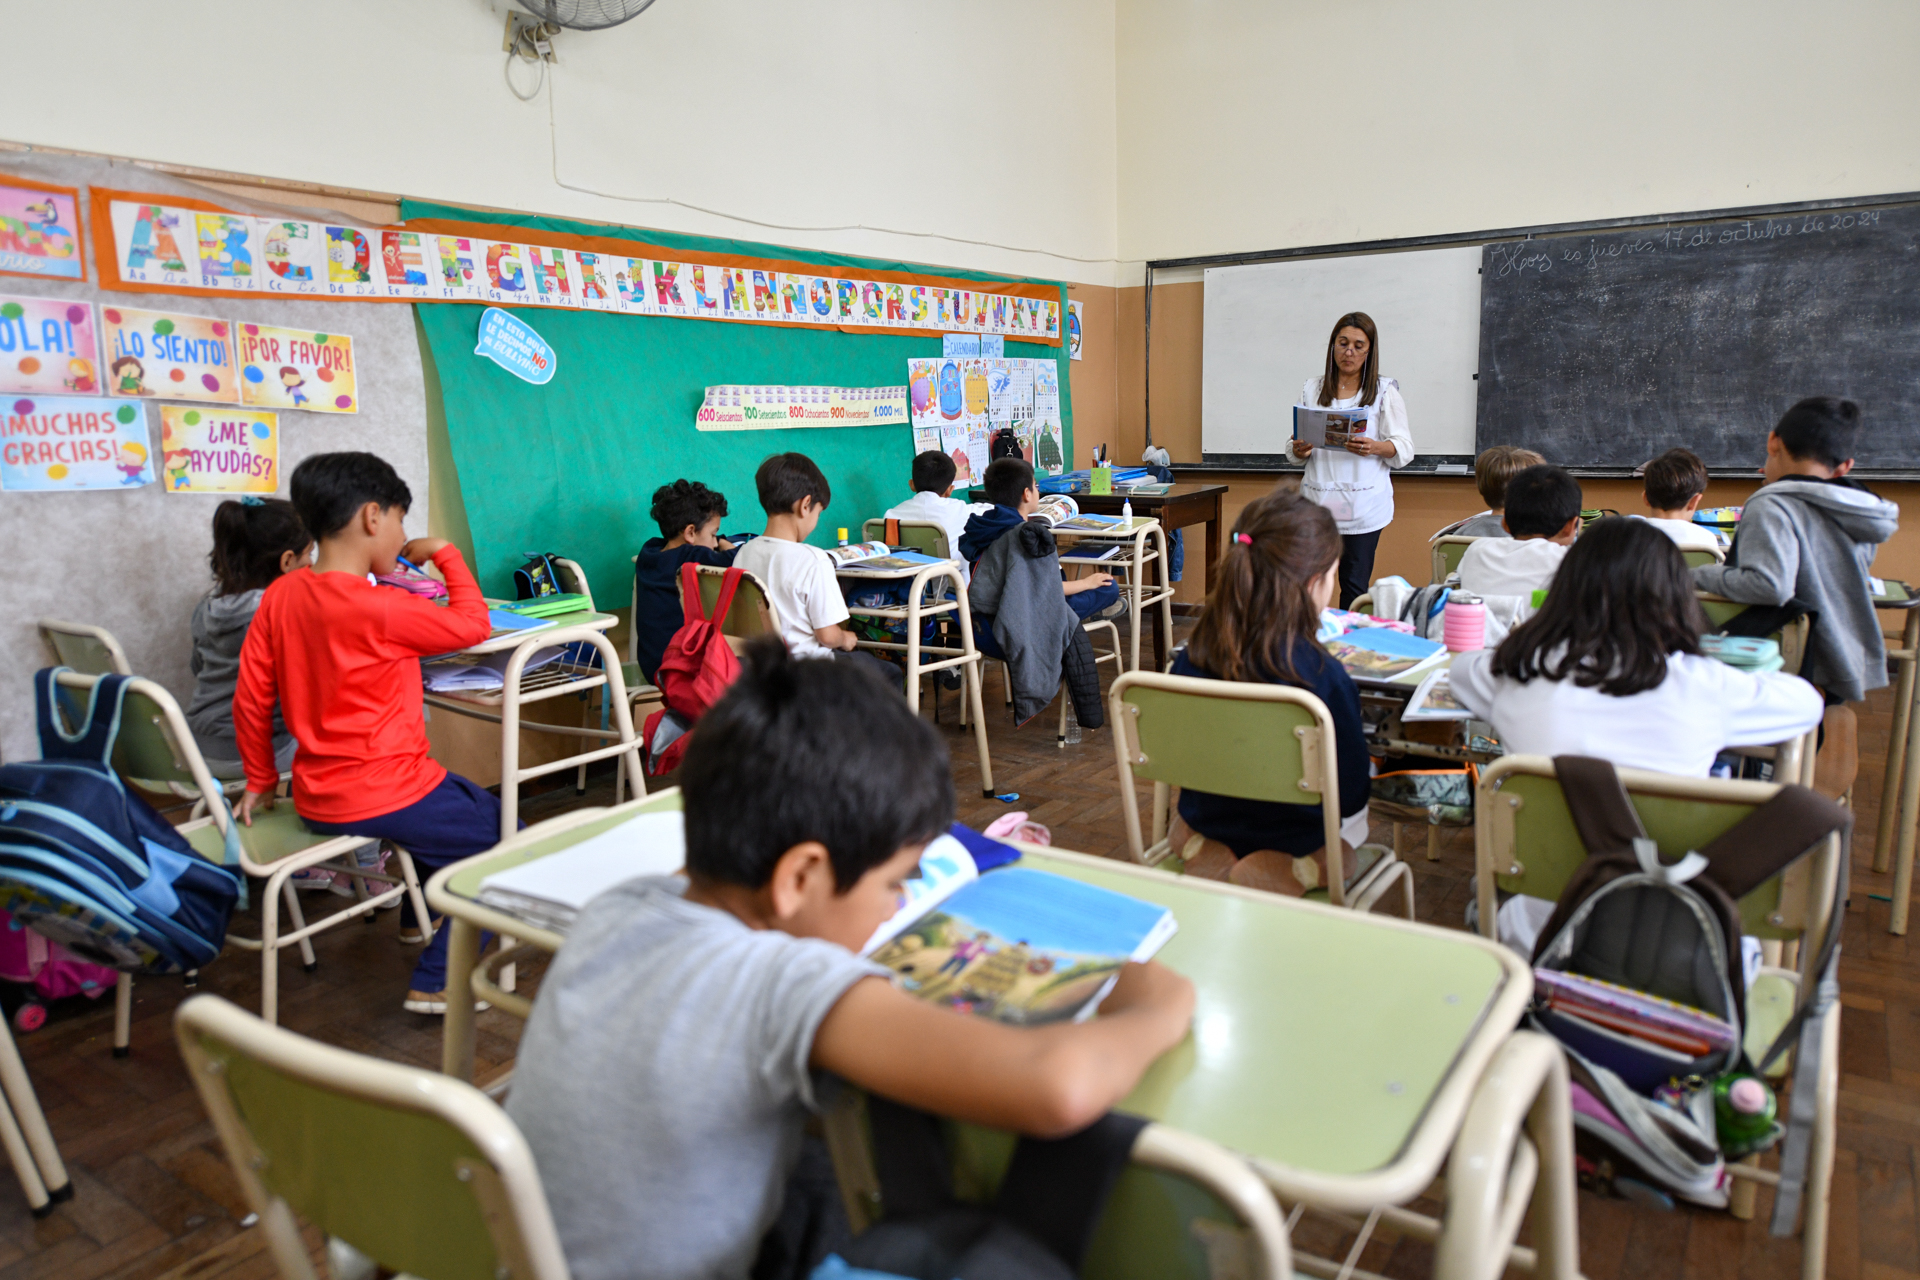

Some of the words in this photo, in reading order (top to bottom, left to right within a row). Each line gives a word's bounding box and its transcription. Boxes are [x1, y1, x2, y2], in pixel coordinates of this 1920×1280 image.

[1491, 243, 1552, 276] Hoy
[1561, 249, 1582, 261] es
[1660, 228, 1685, 249] 17
[1685, 226, 1714, 247] de
[1718, 219, 1793, 245] octubre
[1797, 215, 1825, 235] de
[1829, 211, 1881, 231] 2024
[127, 206, 187, 272] A
[195, 214, 252, 276] B
[265, 222, 313, 281] C
[326, 226, 370, 283] D
[382, 231, 428, 285] E
[438, 236, 472, 287] F
[486, 244, 526, 292] G
[529, 246, 571, 296] H
[616, 258, 645, 303] J
[653, 261, 686, 306] K
[692, 265, 718, 309] L
[753, 271, 779, 312] N
[782, 274, 807, 314] Ñ
[810, 278, 833, 316] O
[837, 280, 858, 317] P
[862, 282, 883, 319] Q
[886, 284, 905, 320] R
[910, 286, 928, 321] S
[932, 288, 949, 323] T
[954, 291, 970, 325] U
[974, 293, 989, 326] V
[1010, 297, 1025, 328] X
[1027, 299, 1040, 330] Y
[152, 333, 228, 367] SIENTO!
[486, 322, 497, 335] LE
[497, 328, 533, 357] DECIMOS
[531, 352, 547, 370] NO
[493, 312, 506, 327] EN
[506, 321, 525, 340] ESTA
[525, 336, 546, 355] AULA
[950, 342, 979, 354] CALENDARIO
[982, 341, 995, 354] 2024
[241, 337, 282, 363] ¡POR
[290, 340, 351, 373] FAVOR!
[493, 340, 541, 376] BULLYING
[0, 411, 116, 438] ¡MUCHAS
[698, 407, 715, 422] 600
[716, 411, 743, 422] Seiscientos
[758, 410, 787, 420] Setecientos
[789, 405, 804, 419] 800
[805, 409, 829, 418] Ochocientos
[830, 406, 845, 419] 900
[845, 410, 869, 419] Novecientos
[874, 404, 893, 417] 1.000
[894, 406, 903, 416] Mil
[208, 420, 249, 446] ¿ME
[3, 439, 120, 465] GRACIAS!
[191, 447, 273, 480] AYUDÁS?
